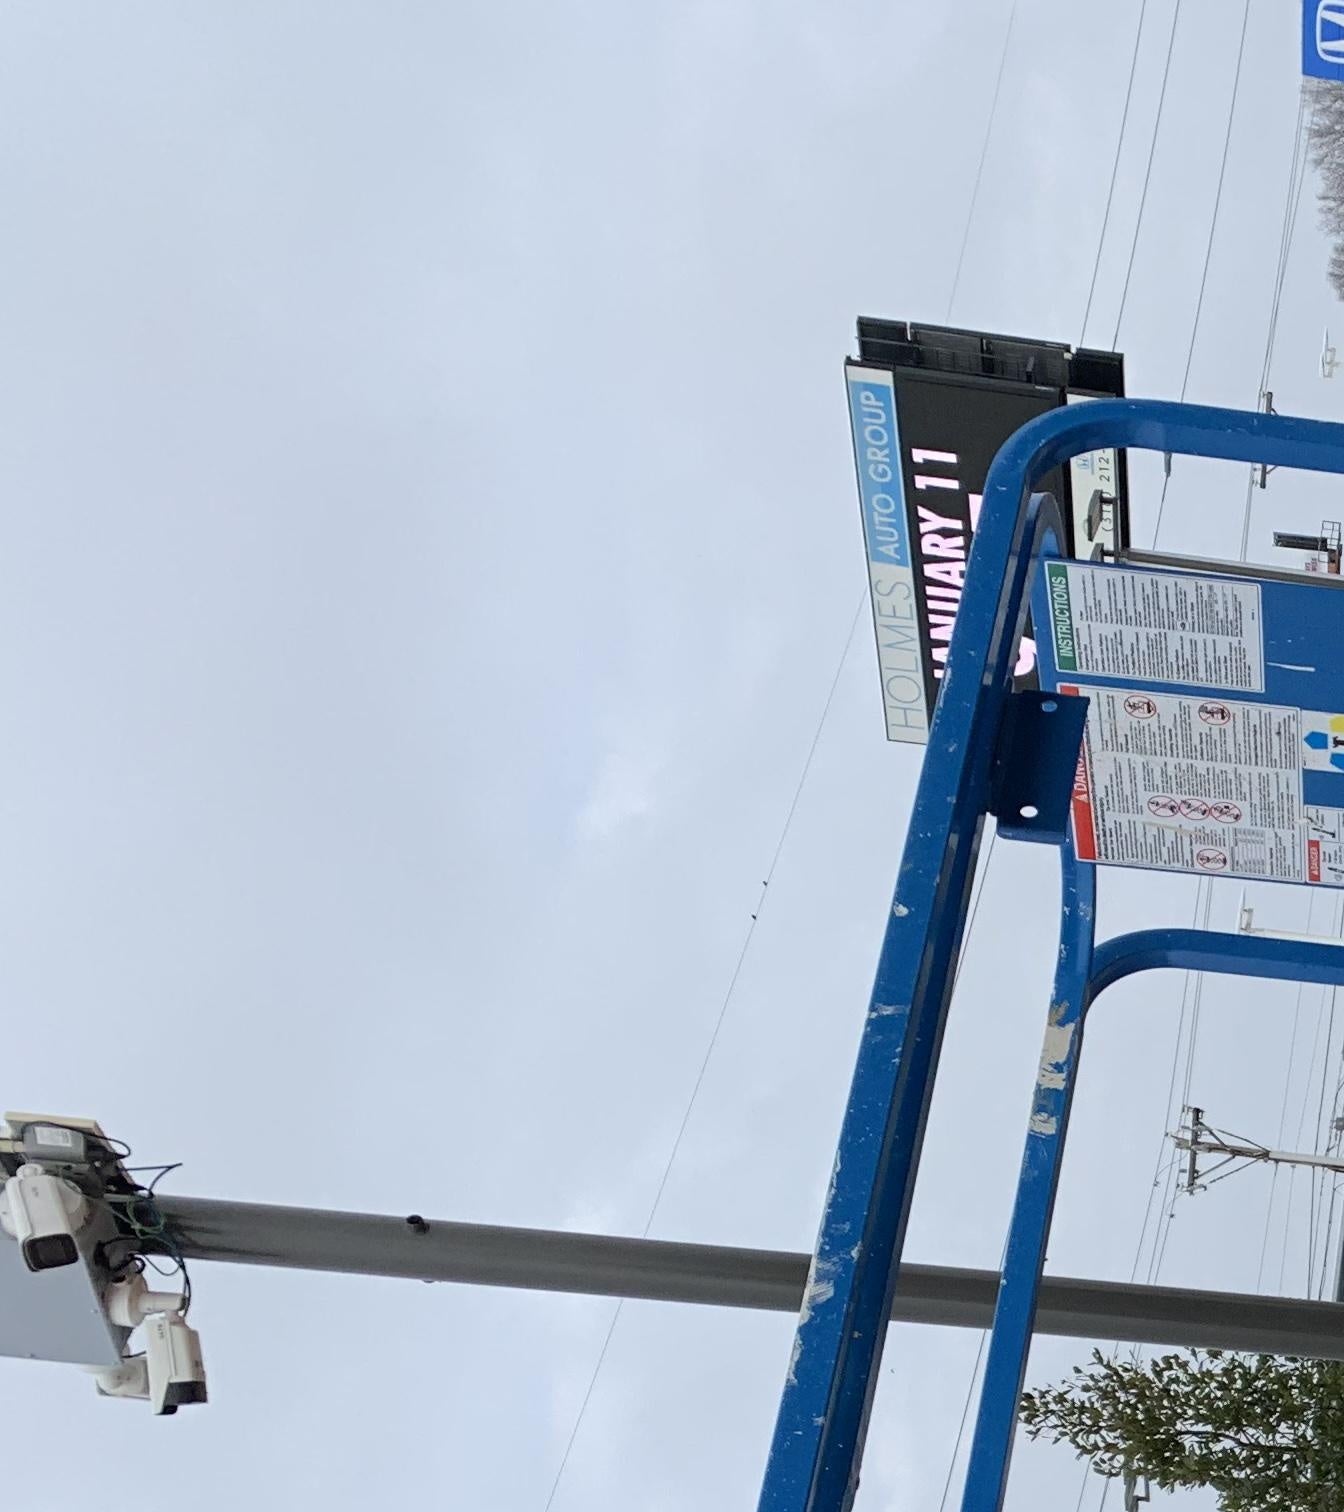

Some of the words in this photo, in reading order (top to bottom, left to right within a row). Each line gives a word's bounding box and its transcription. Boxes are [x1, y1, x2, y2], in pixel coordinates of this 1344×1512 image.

[859, 390, 891, 483] GROUP
[912, 448, 960, 491] 11
[870, 494, 902, 561] AUTO
[874, 577, 925, 730] HOLMES
[1051, 576, 1073, 657] INSTRUCTIONS
